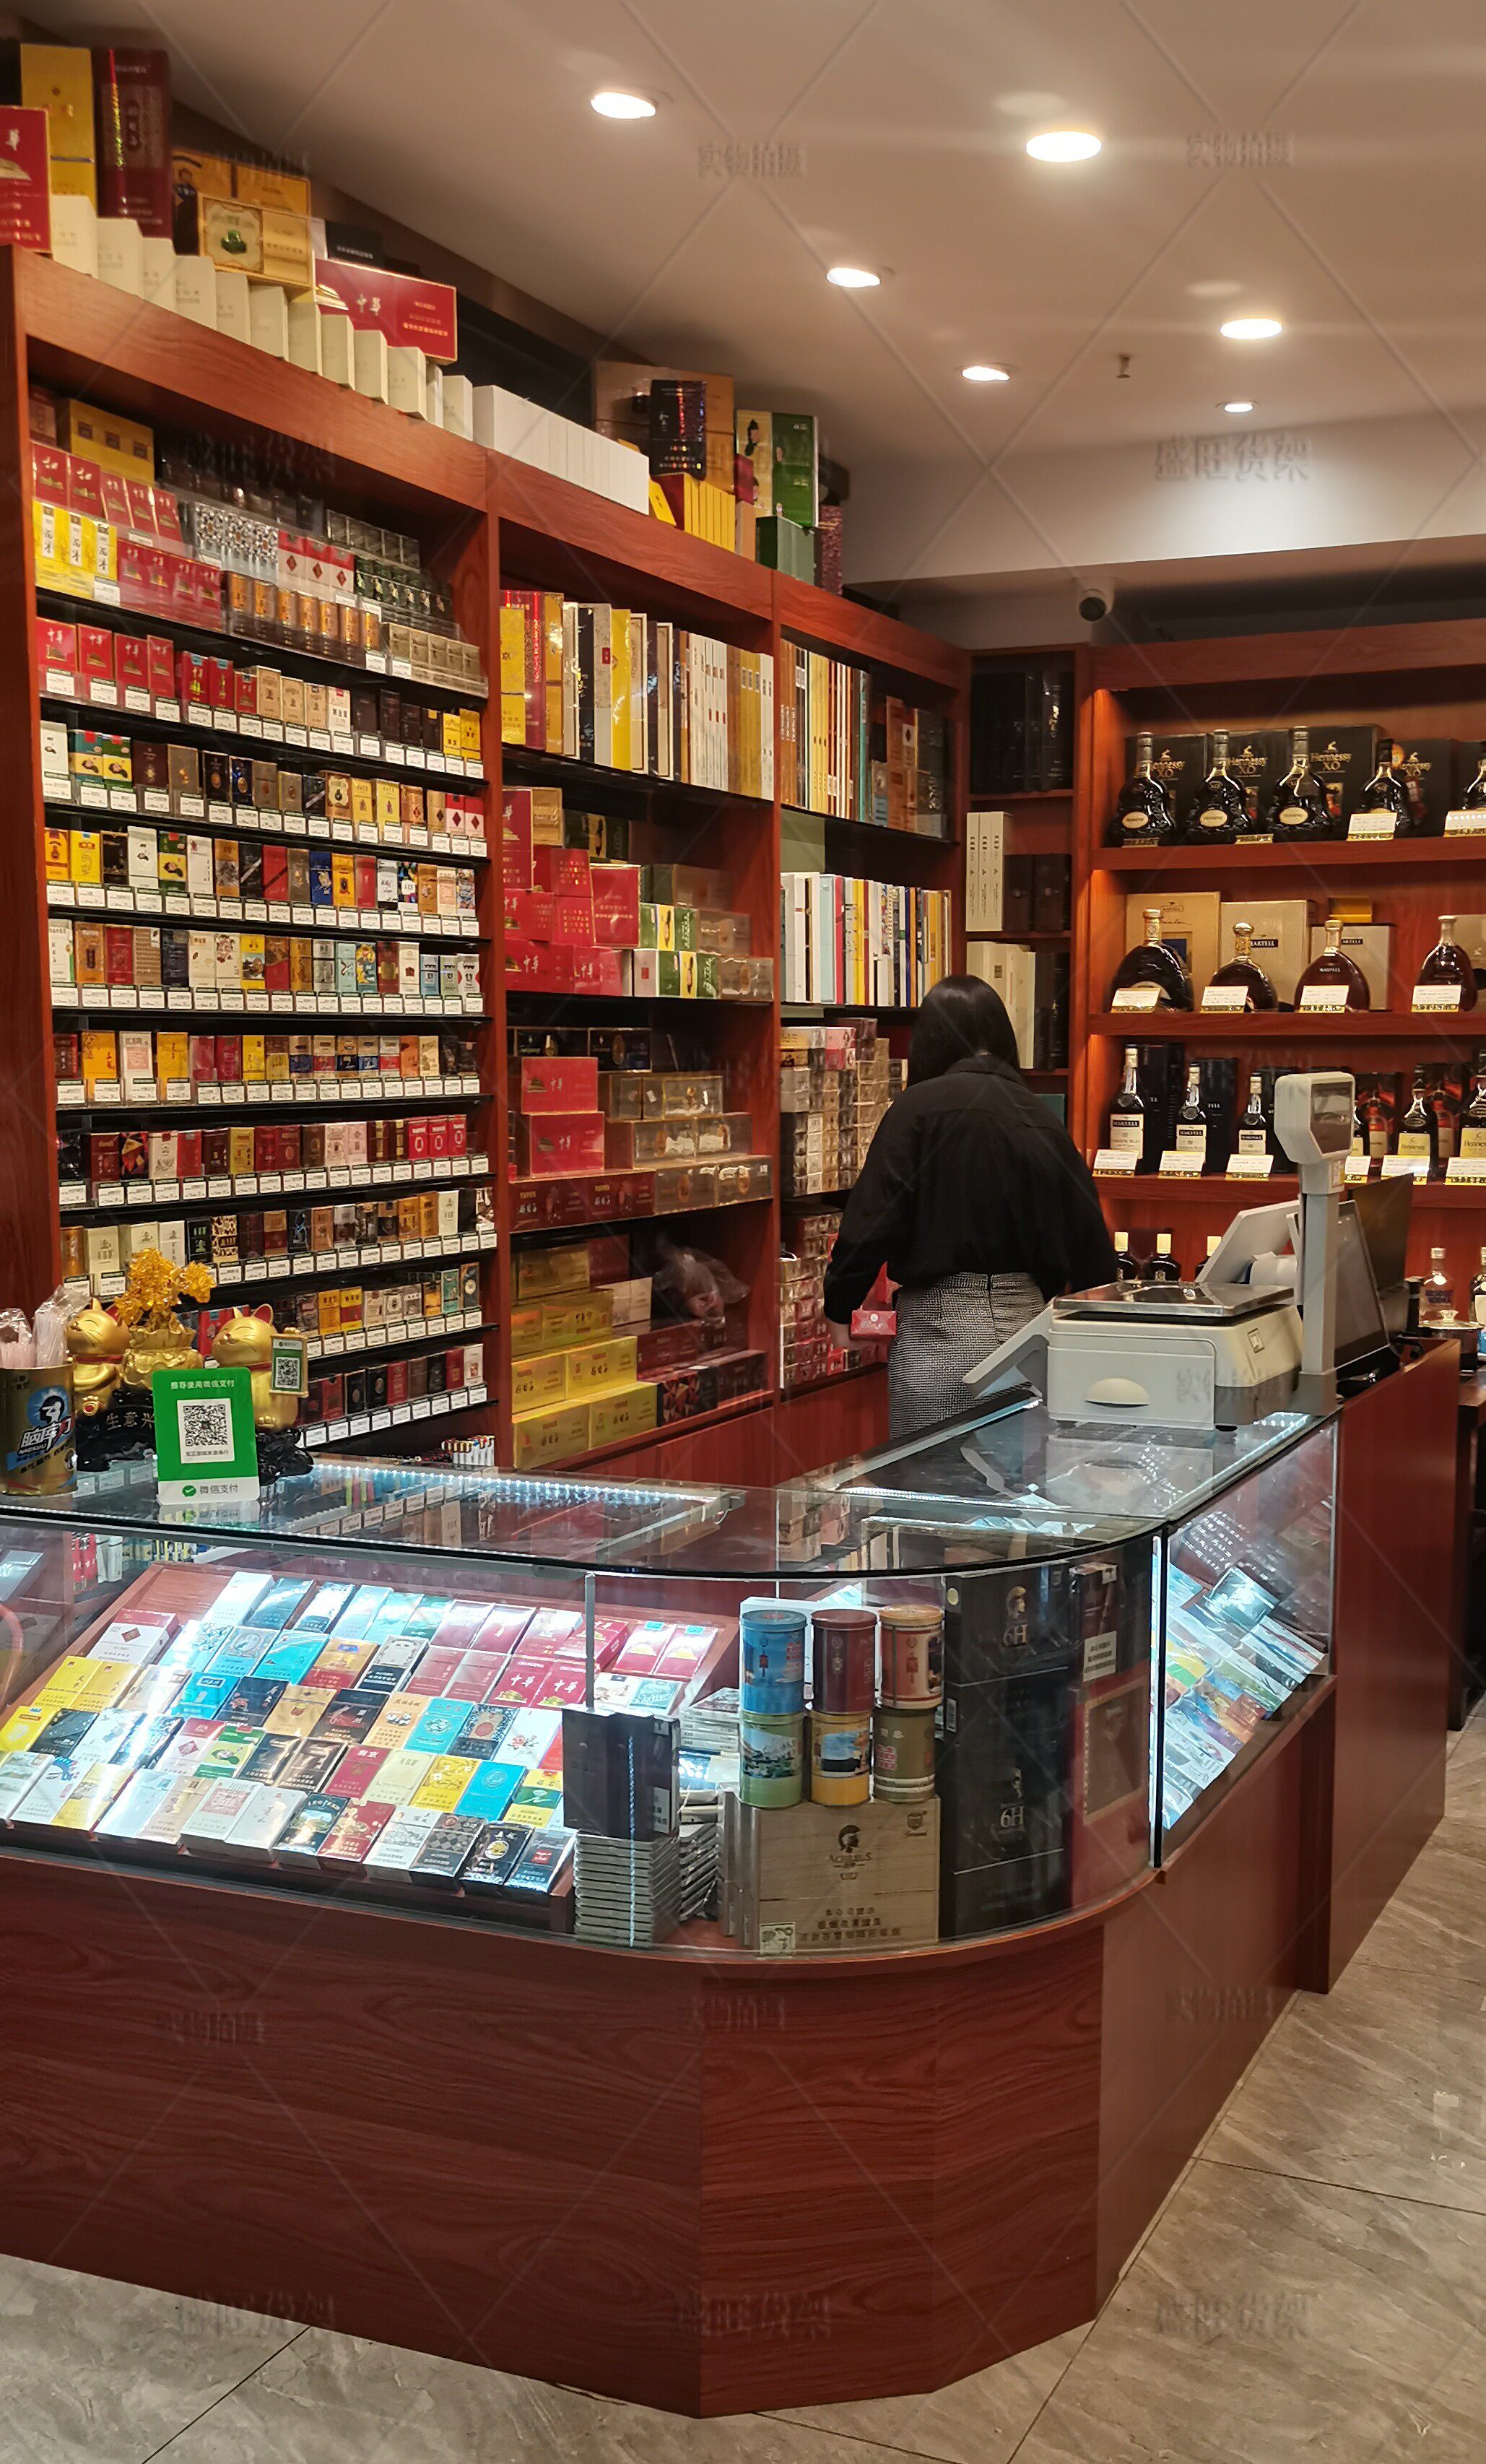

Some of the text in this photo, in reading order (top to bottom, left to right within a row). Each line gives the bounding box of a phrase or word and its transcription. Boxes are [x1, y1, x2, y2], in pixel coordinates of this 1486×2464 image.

[1311, 752, 1352, 763] Hennessy
[1323, 760, 1341, 771] XO
[199, 1483, 239, 1495] 微信支付
[1002, 1623, 1029, 1647] 6H
[509, 1673, 536, 1688] 中华
[553, 1678, 578, 1693] 中华
[999, 1805, 1025, 1829] 6H
